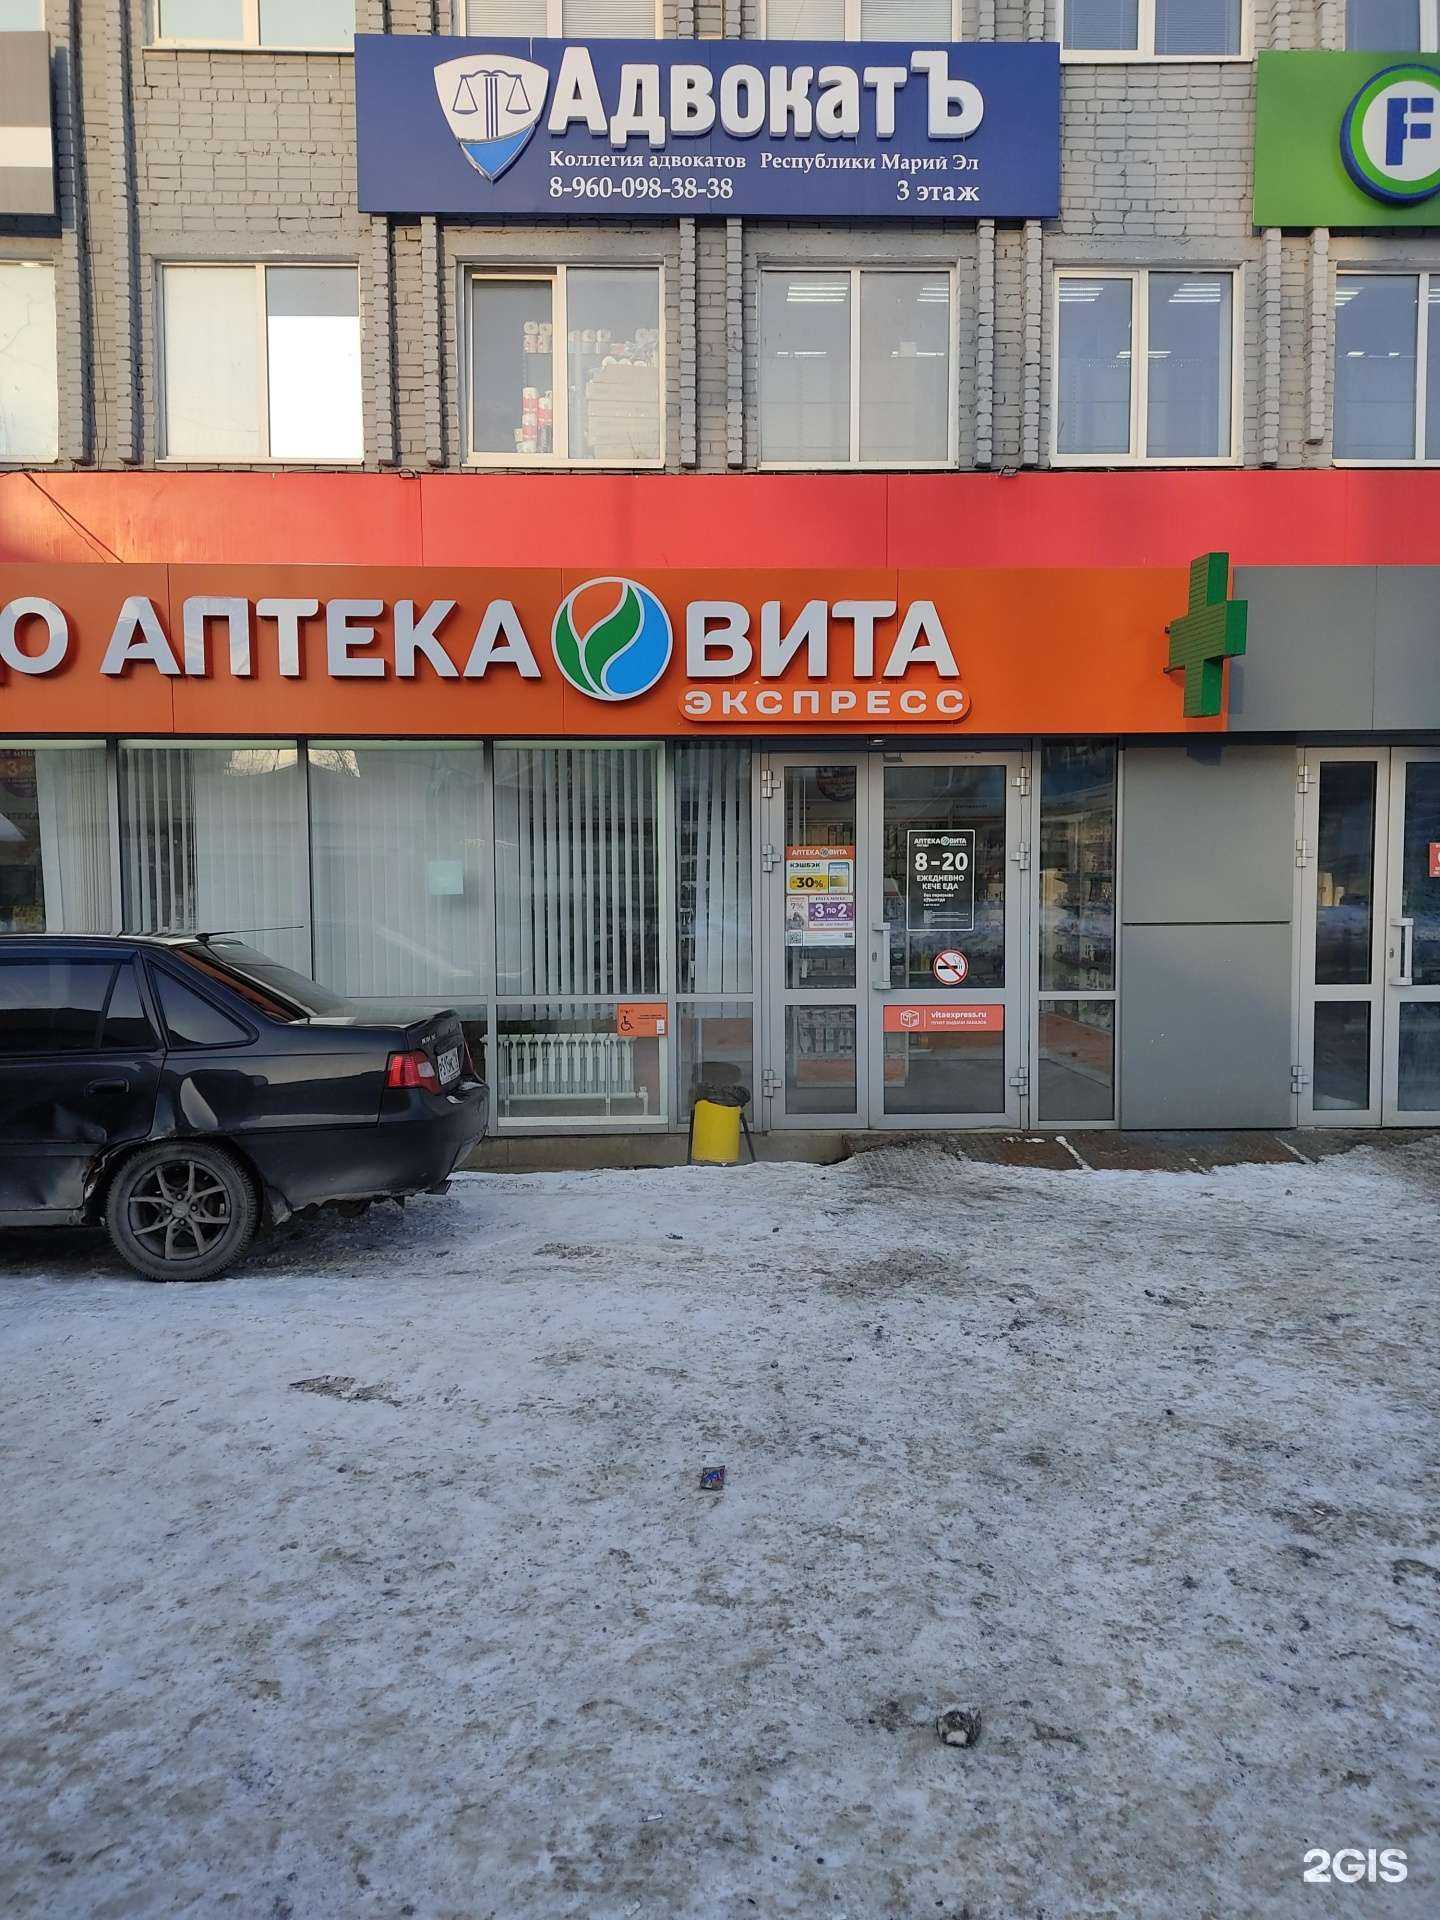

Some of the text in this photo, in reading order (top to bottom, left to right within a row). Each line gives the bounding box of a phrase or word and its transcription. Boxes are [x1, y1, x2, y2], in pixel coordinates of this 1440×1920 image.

[547, 46, 984, 148] АдвокатЪ
[549, 151, 979, 174] Коллегия адвокатов Республики Марий Эл
[549, 176, 734, 199] 8-960-098-38-38
[896, 180, 980, 202] 3 этаж
[100, 595, 542, 678] АПТЕКА
[686, 600, 960, 677] ВИТА
[684, 690, 964, 715] ЭКСПРЕСС
[914, 837, 941, 845] АПТЕКА
[916, 874, 965, 882] ЕЖЕДНЕВНО
[814, 903, 825, 918] 3
[837, 903, 848, 918] 2
[930, 1010, 987, 1019] vitaexpress.ru
